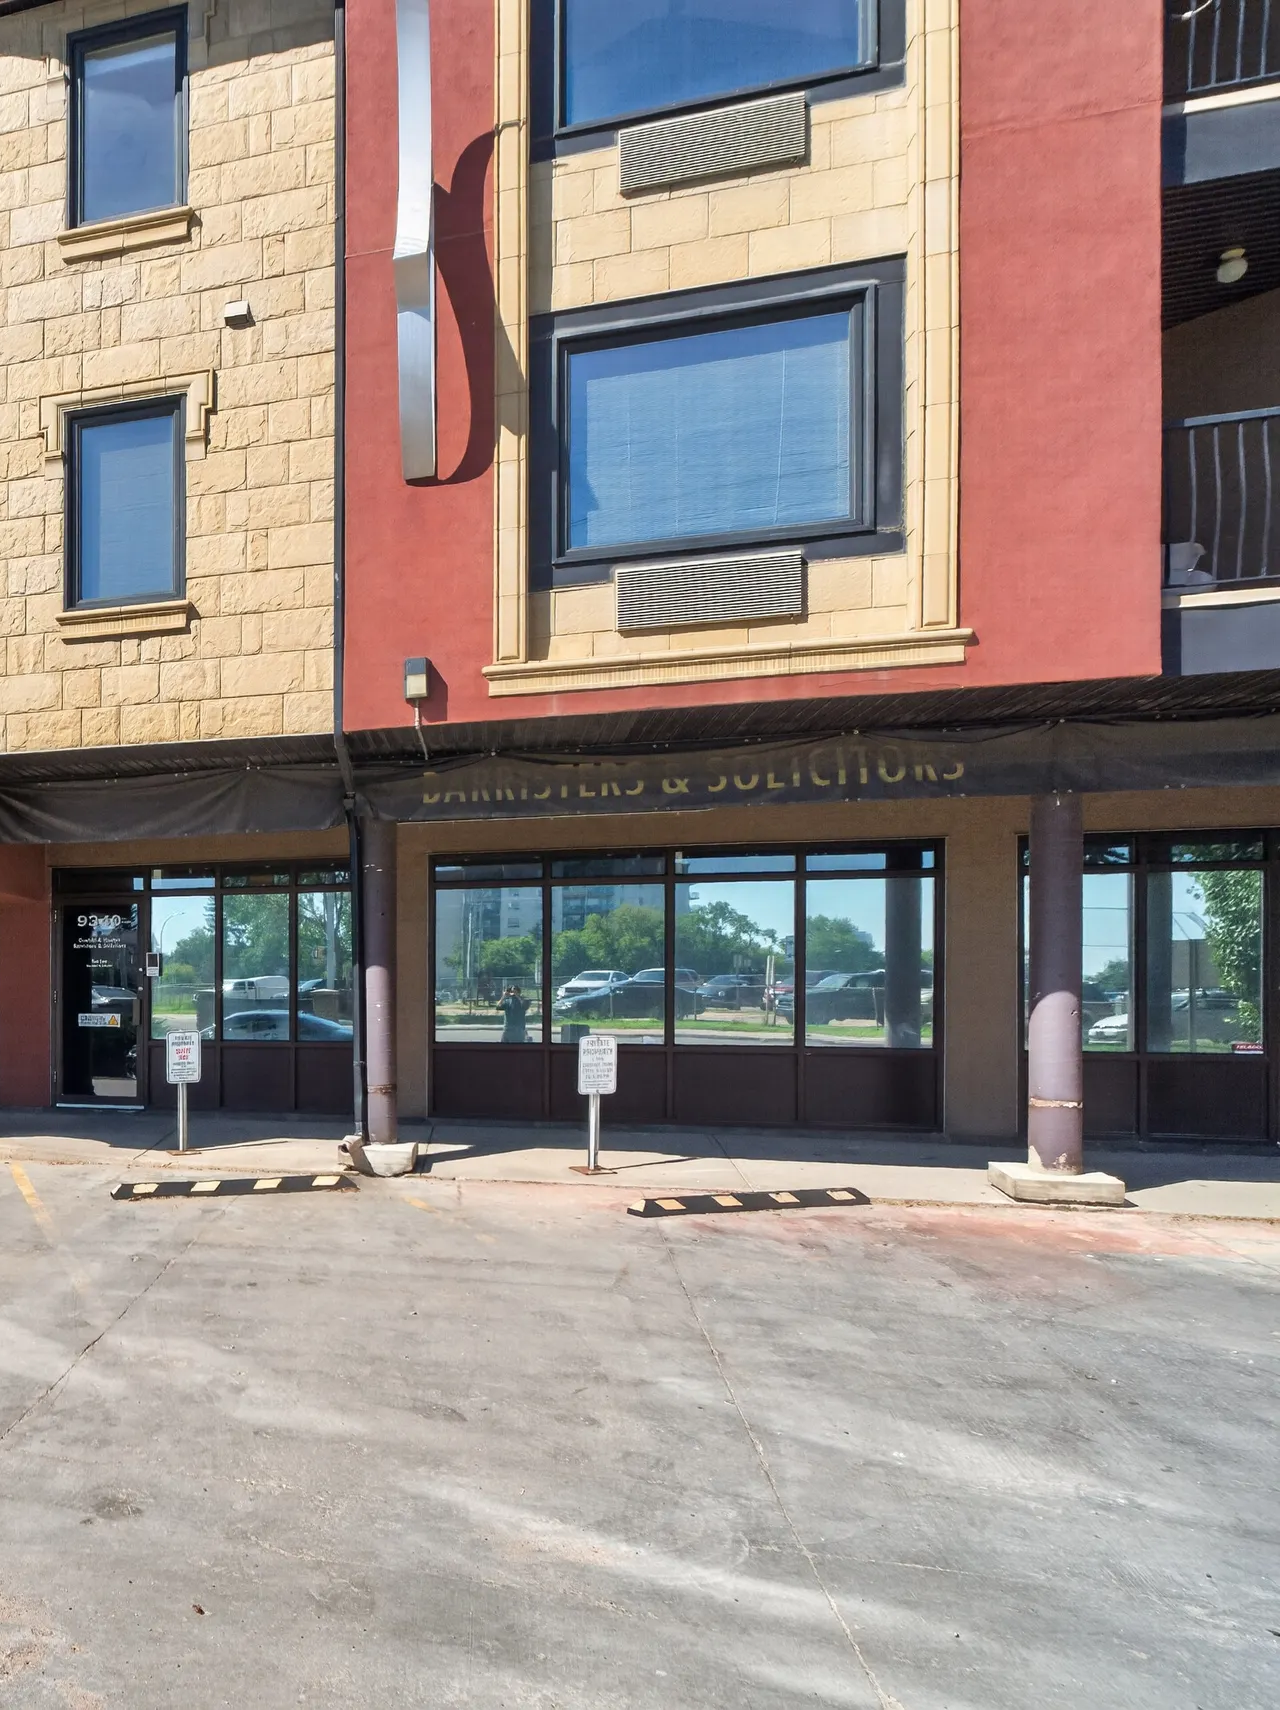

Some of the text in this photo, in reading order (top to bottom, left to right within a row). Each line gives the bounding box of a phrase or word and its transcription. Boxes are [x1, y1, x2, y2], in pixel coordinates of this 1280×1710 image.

[422, 746, 966, 804] BARRISTERS & SOLICITORS
